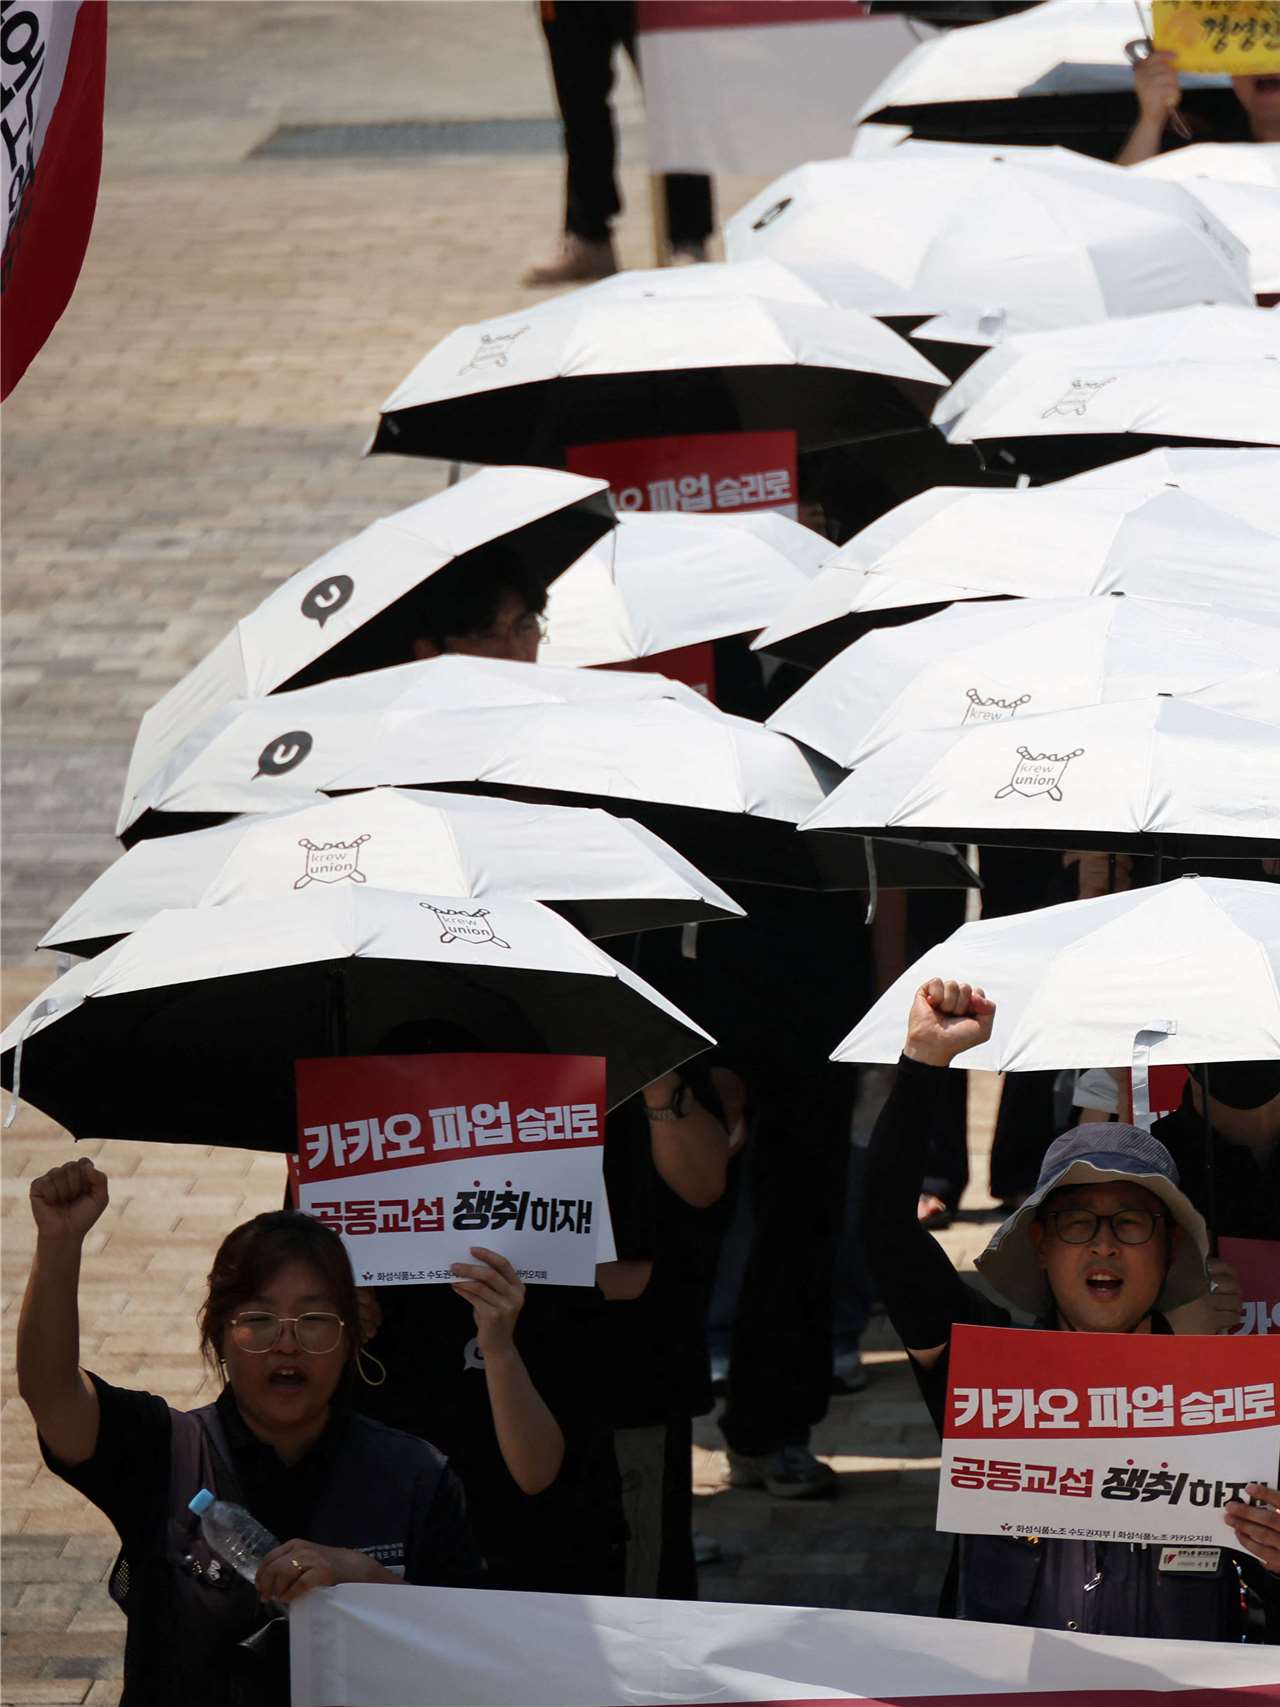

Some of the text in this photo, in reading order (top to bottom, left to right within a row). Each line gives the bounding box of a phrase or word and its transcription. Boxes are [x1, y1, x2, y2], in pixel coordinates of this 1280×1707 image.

[647, 474, 712, 512] 파업
[715, 470, 791, 508] 승리로
[969, 708, 1002, 721] krew
[1020, 763, 1055, 773] krew
[1015, 775, 1056, 786] union
[311, 851, 348, 863] krew
[310, 862, 353, 874] union
[442, 915, 477, 926] krew
[449, 925, 491, 937] union
[304, 1101, 599, 1169] 카카오 파업 승리로
[311, 1196, 444, 1235] 공동교섭
[953, 1382, 1276, 1429] 카카오 파업 승리로
[950, 1456, 1094, 1498] 공동교섭
[1069, 1527, 1111, 1539] 수도권지부
[1170, 1533, 1213, 1543] 카카오지회
